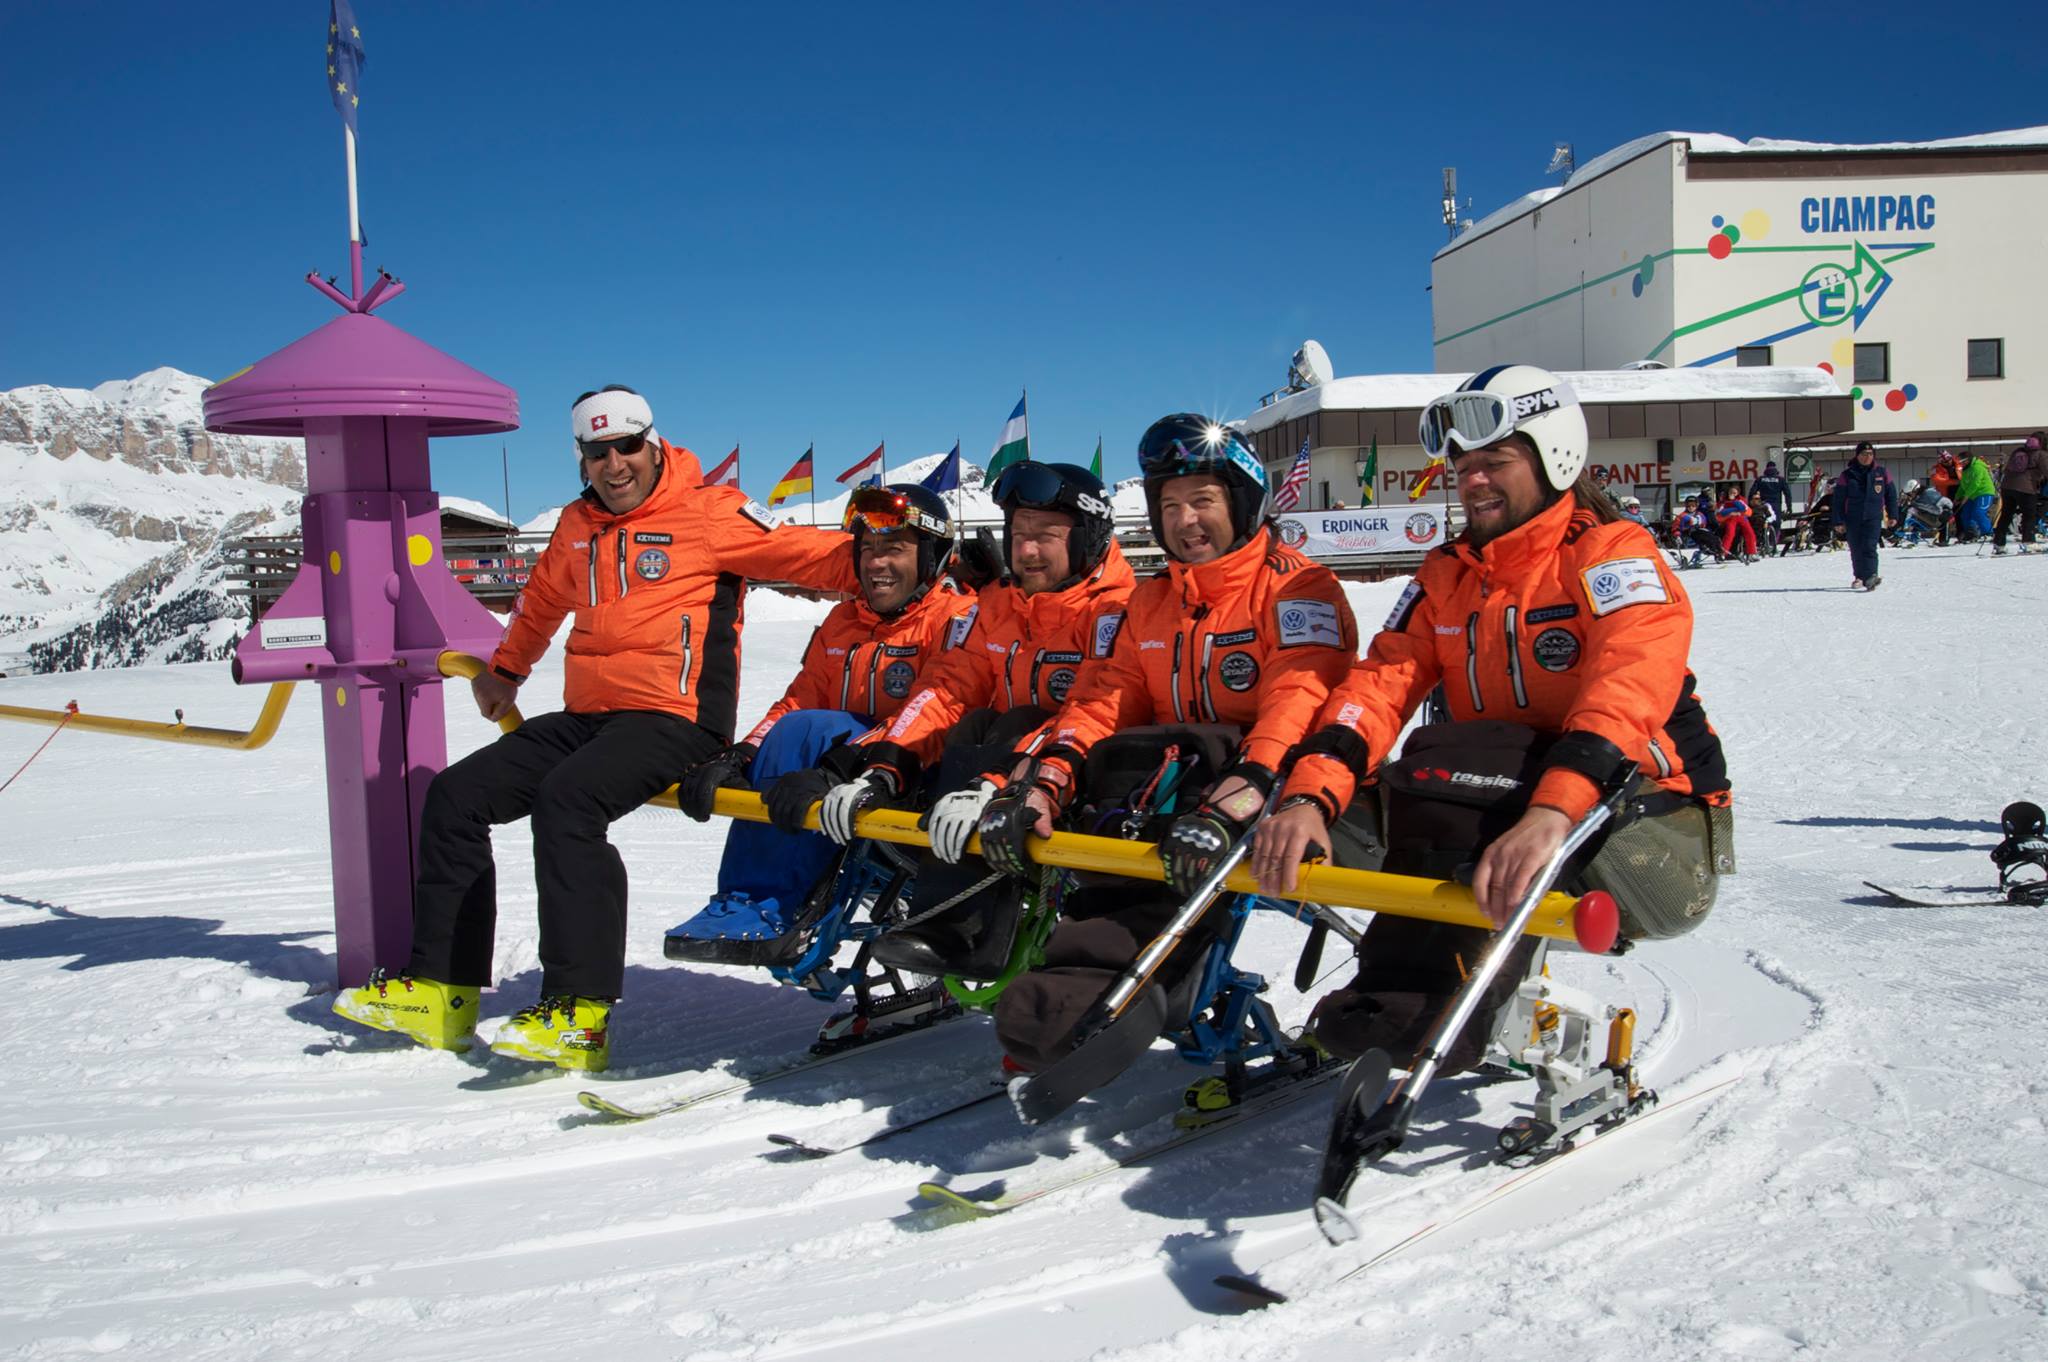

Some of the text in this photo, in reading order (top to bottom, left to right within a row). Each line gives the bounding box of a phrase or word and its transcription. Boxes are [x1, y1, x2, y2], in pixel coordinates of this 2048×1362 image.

[1801, 194, 1935, 233] CIAMPAC
[1709, 459, 1758, 481] BAR
[1322, 518, 1389, 534] ERDINGER
[1450, 771, 1520, 789] tessier
[367, 1001, 421, 1013] FISCHER
